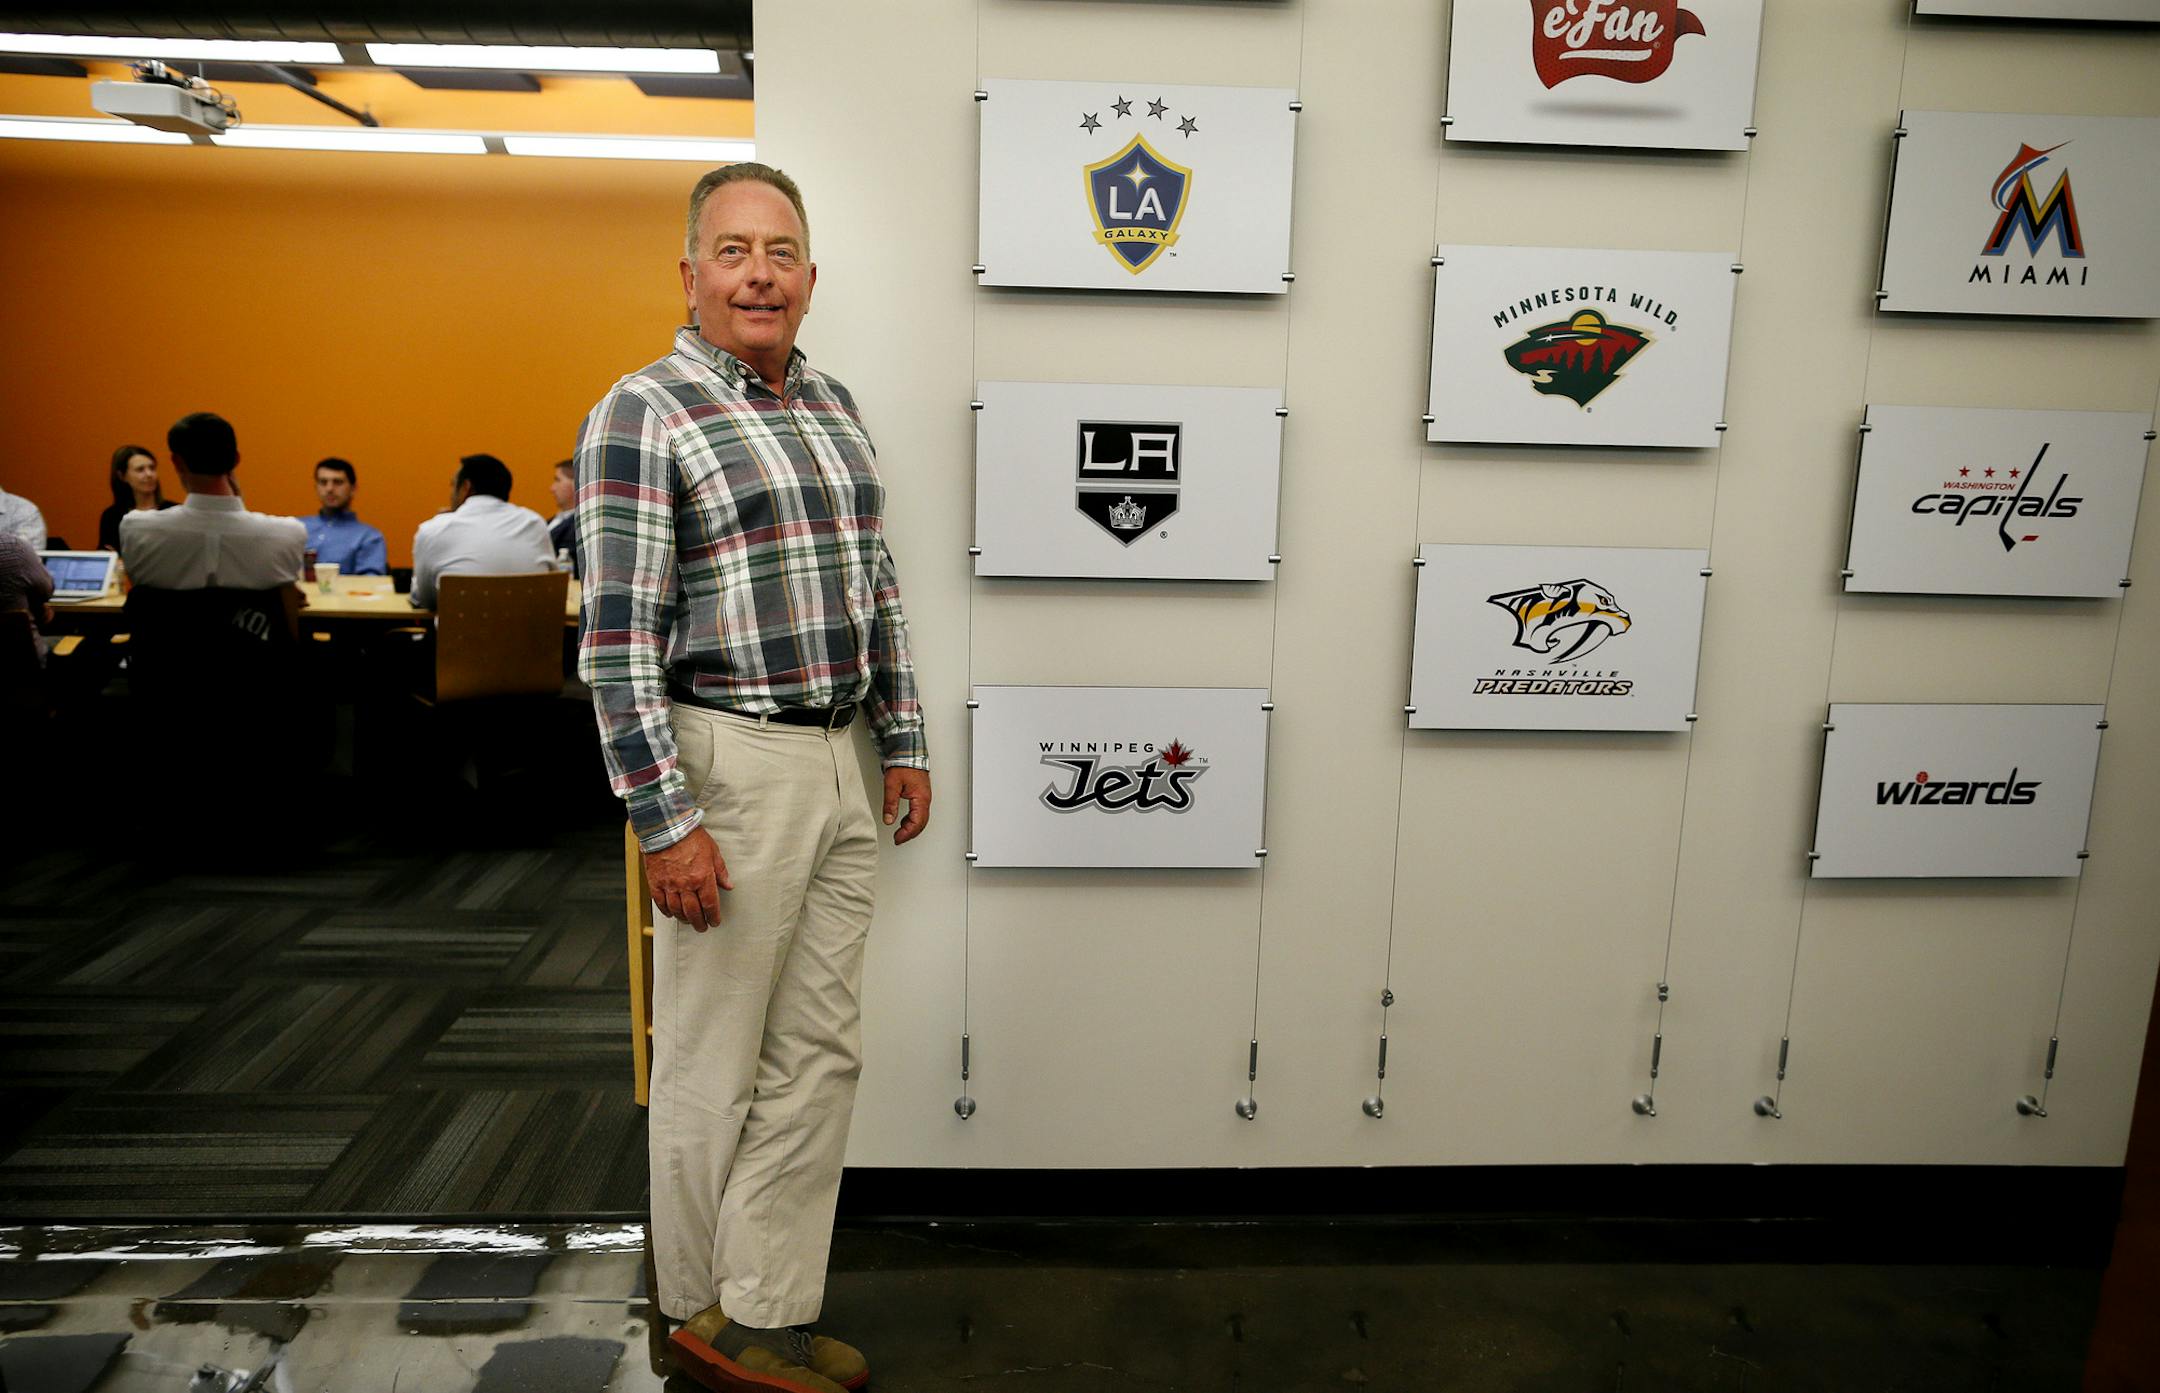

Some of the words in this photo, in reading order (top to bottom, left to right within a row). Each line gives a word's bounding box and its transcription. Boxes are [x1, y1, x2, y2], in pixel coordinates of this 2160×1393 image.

[1543, 0, 1664, 48] eFan
[1107, 185, 1167, 221] LA
[1103, 229, 1169, 241] GALAXY
[1968, 264, 2088, 286] MIAMI
[1493, 286, 1617, 329] MINNESOTA
[1630, 292, 1678, 326] WILD
[1082, 431, 1176, 472] LA
[1911, 443, 2084, 552] capitals
[1942, 481, 2018, 491] WASHINGTON
[1472, 678, 1633, 695] PREDATORS
[1495, 669, 1619, 678] NASHVILLE
[1039, 742, 1155, 753] WINNIPEG
[1040, 755, 1208, 813] Jets
[1876, 767, 2042, 805] wizards
